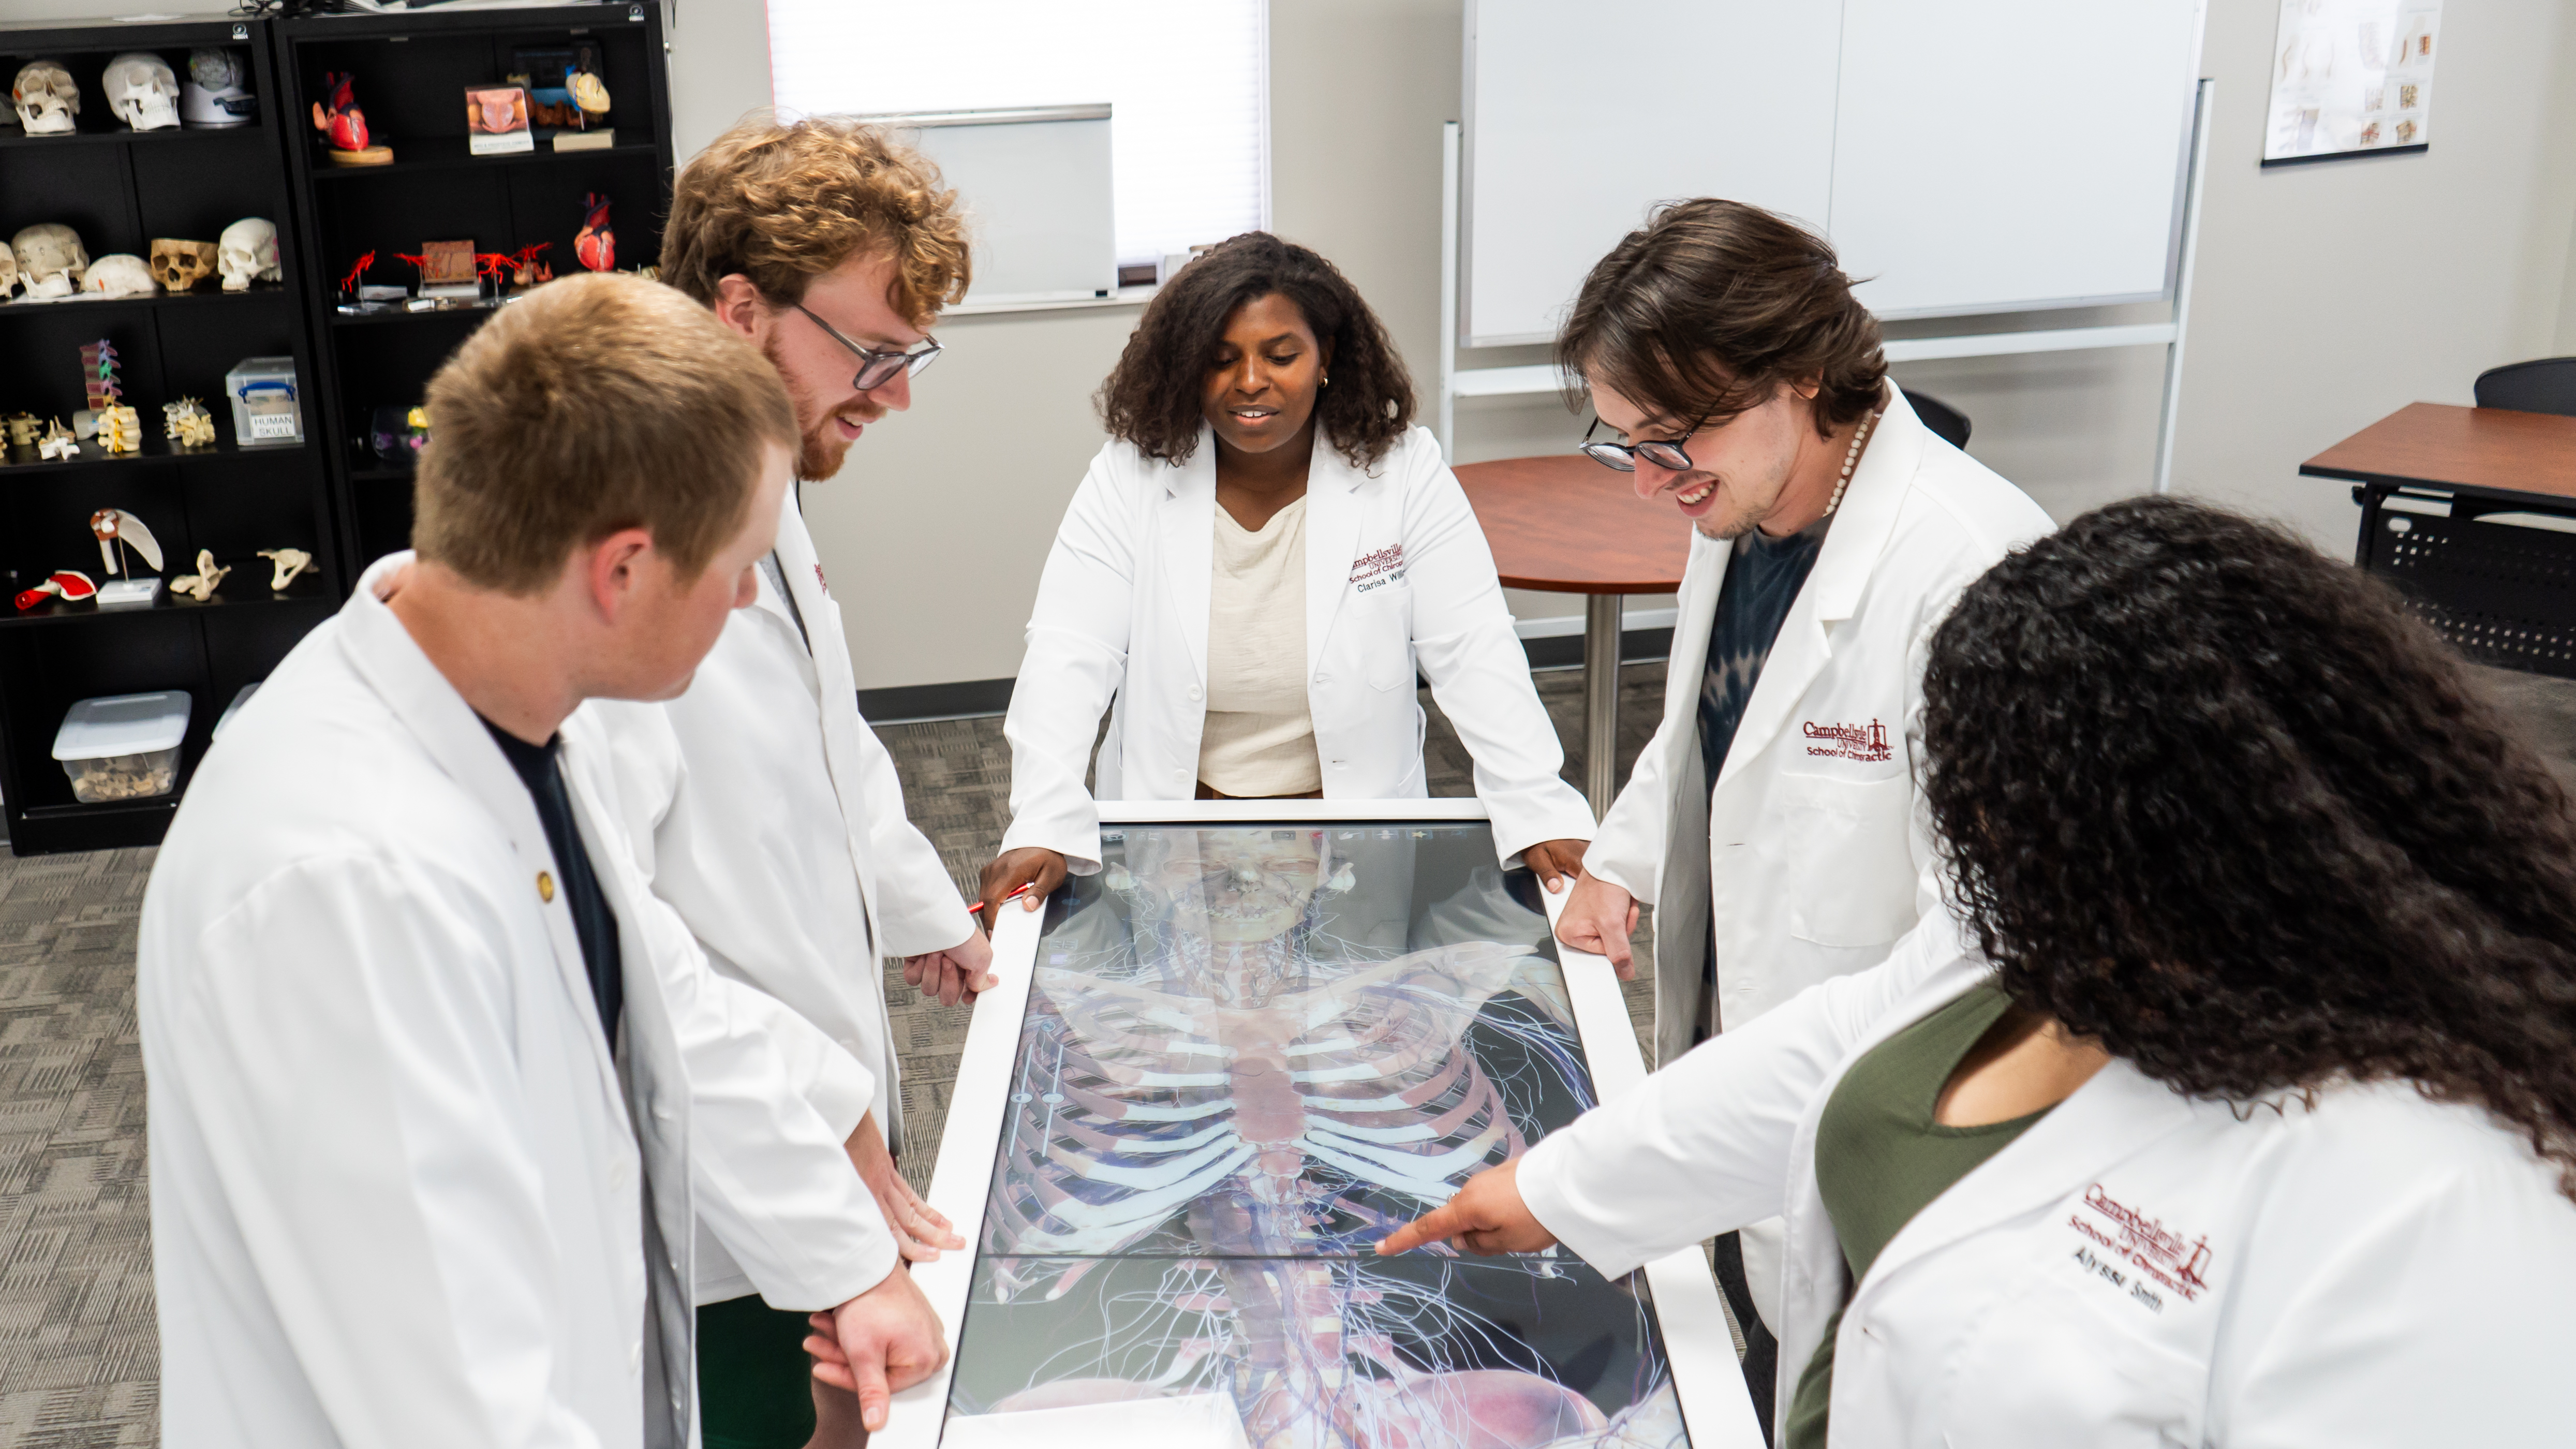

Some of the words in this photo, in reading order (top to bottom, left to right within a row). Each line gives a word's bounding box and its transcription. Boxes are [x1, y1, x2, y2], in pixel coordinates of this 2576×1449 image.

[255, 417, 292, 426] HUMAN
[260, 427, 291, 437] SKULL
[1352, 543, 1402, 568] mpbellsville
[1349, 571, 1373, 584] School
[1357, 579, 1386, 593] Clarisa
[1807, 747, 1838, 757] School
[2067, 1215, 2115, 1248] School
[2115, 1245, 2131, 1259] of
